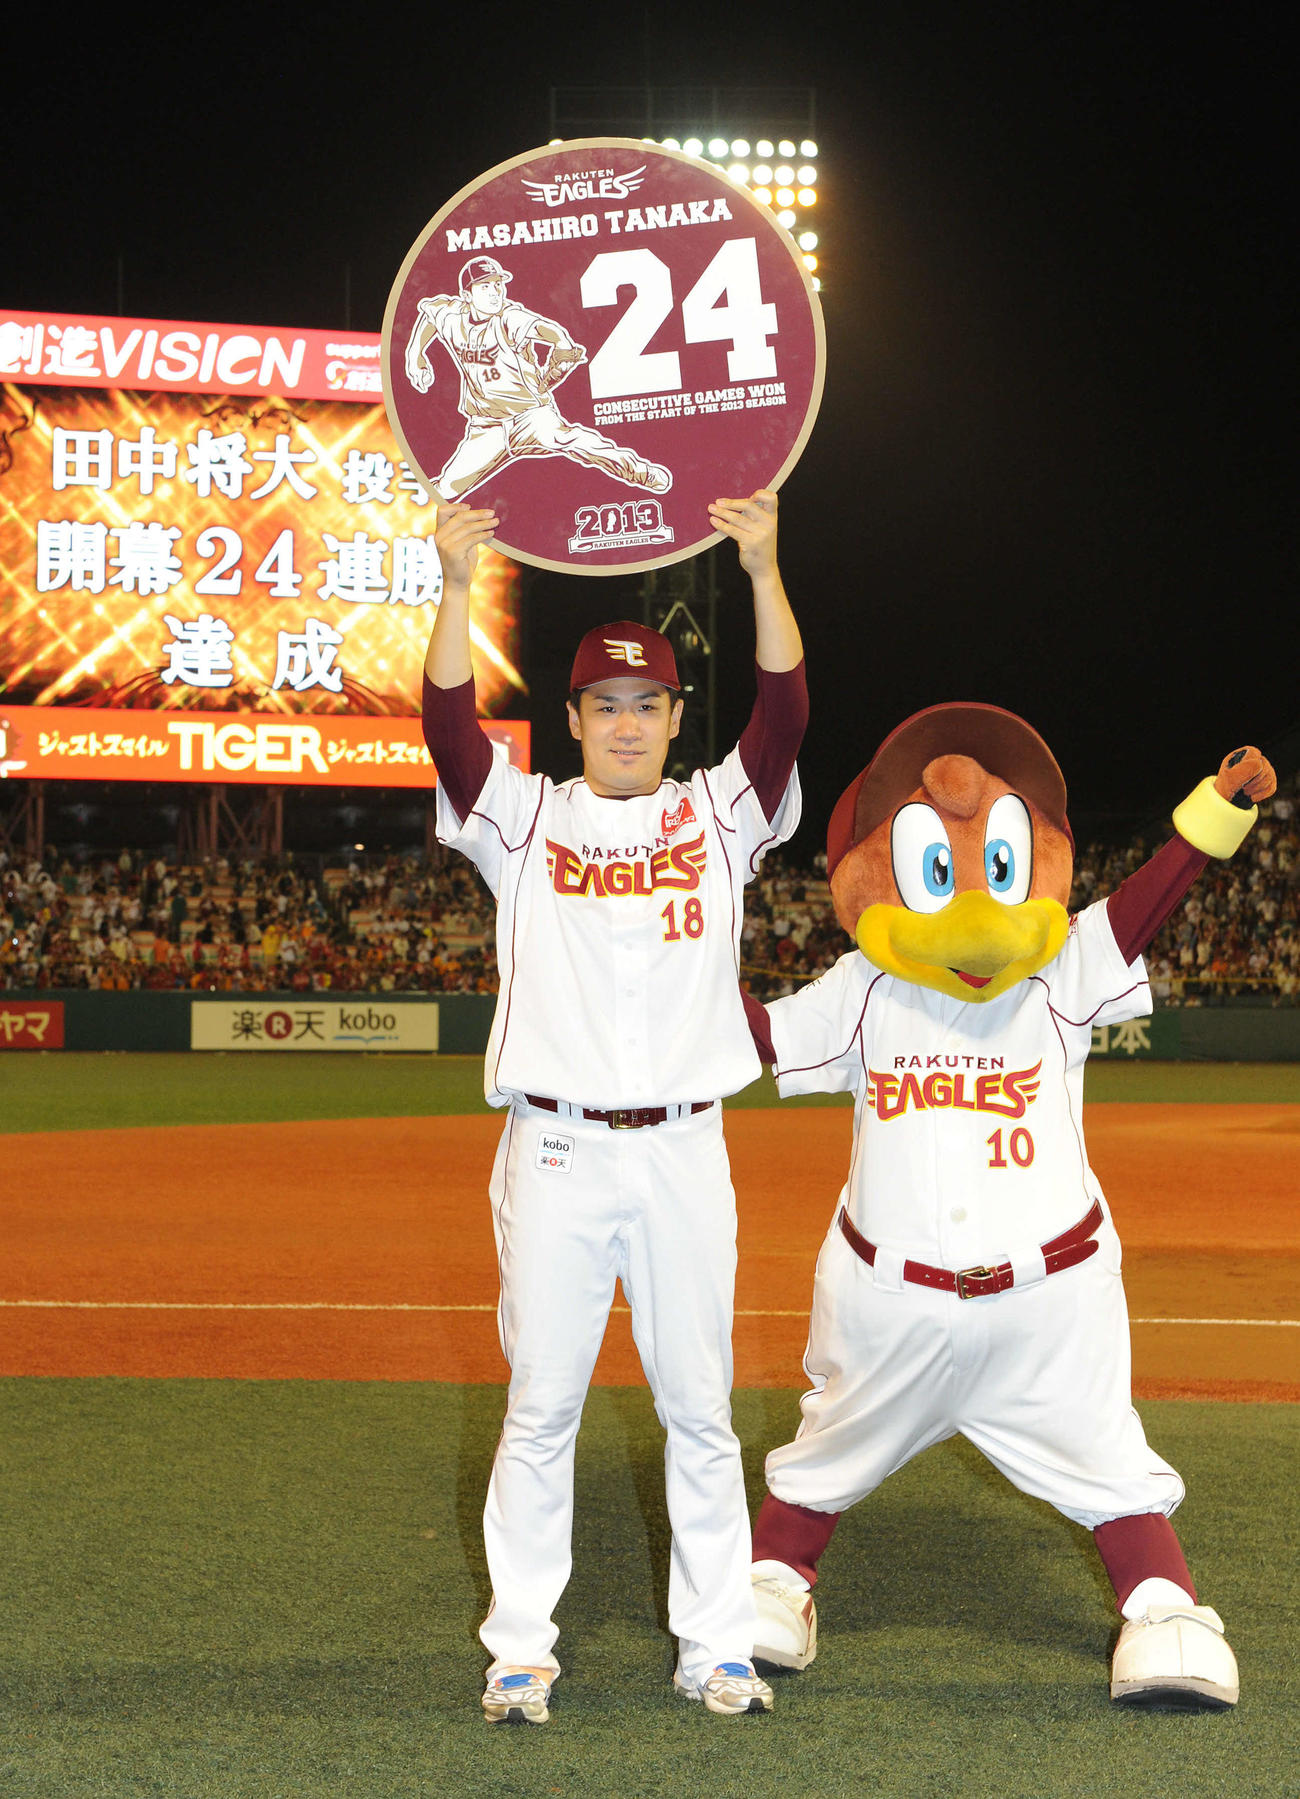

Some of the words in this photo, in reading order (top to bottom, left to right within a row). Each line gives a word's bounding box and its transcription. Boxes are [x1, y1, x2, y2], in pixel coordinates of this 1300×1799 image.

[521, 165, 647, 207] EAGLES
[554, 168, 615, 183] RAKUTEN
[446, 213, 599, 252] MASAHIRO
[604, 198, 733, 234] TANAKA
[580, 237, 778, 399] 24
[482, 368, 501, 382] 18
[593, 393, 692, 416] CONSECUTIVE
[694, 387, 746, 404] GAMES
[747, 382, 786, 398] WON
[595, 414, 624, 426] FROM
[626, 412, 646, 423] THE
[647, 408, 682, 420] START
[684, 406, 698, 415] OF
[700, 403, 719, 414] THE
[721, 400, 744, 411] 2013
[745, 396, 787, 409] SEASON
[52, 426, 318, 500] 田中将大
[576, 499, 662, 538] 2013
[167, 721, 330, 773] TIGER
[327, 739, 433, 766] ジャストスマイ
[546, 829, 707, 898] EAGLES
[582, 837, 669, 860] RAKUTN
[661, 897, 705, 943] 18
[340, 1007, 397, 1031] kobo
[894, 1055, 1005, 1071] RAKUTEN
[868, 1057, 1043, 1122] EAGLES
[543, 1137, 570, 1152] kobo
[986, 1127, 1035, 1169] 10
